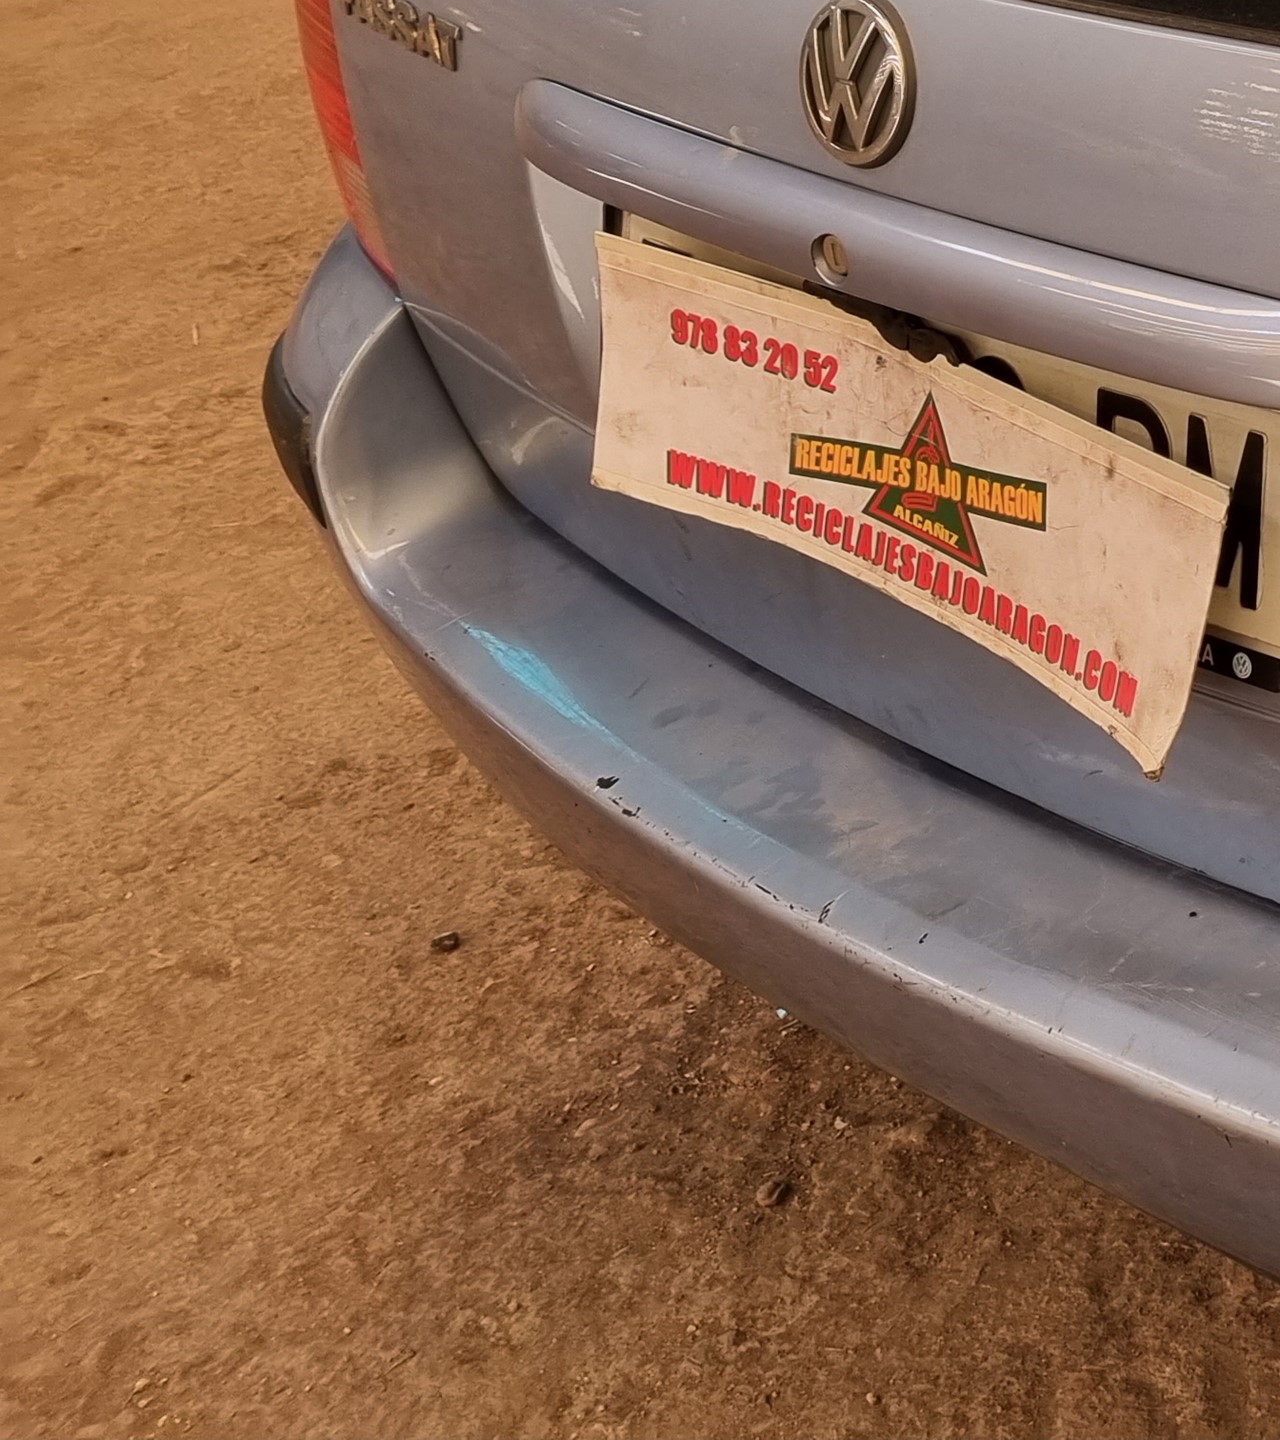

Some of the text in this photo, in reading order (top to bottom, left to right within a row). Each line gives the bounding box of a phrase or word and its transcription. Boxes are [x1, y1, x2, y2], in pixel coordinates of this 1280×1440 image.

[670, 308, 839, 394] 978 83 20 52
[794, 438, 1043, 524] RECICLAJES BAJO ARAGÓN
[667, 448, 1139, 718] WWW.RECICLAJESBAJOARAGON.COM
